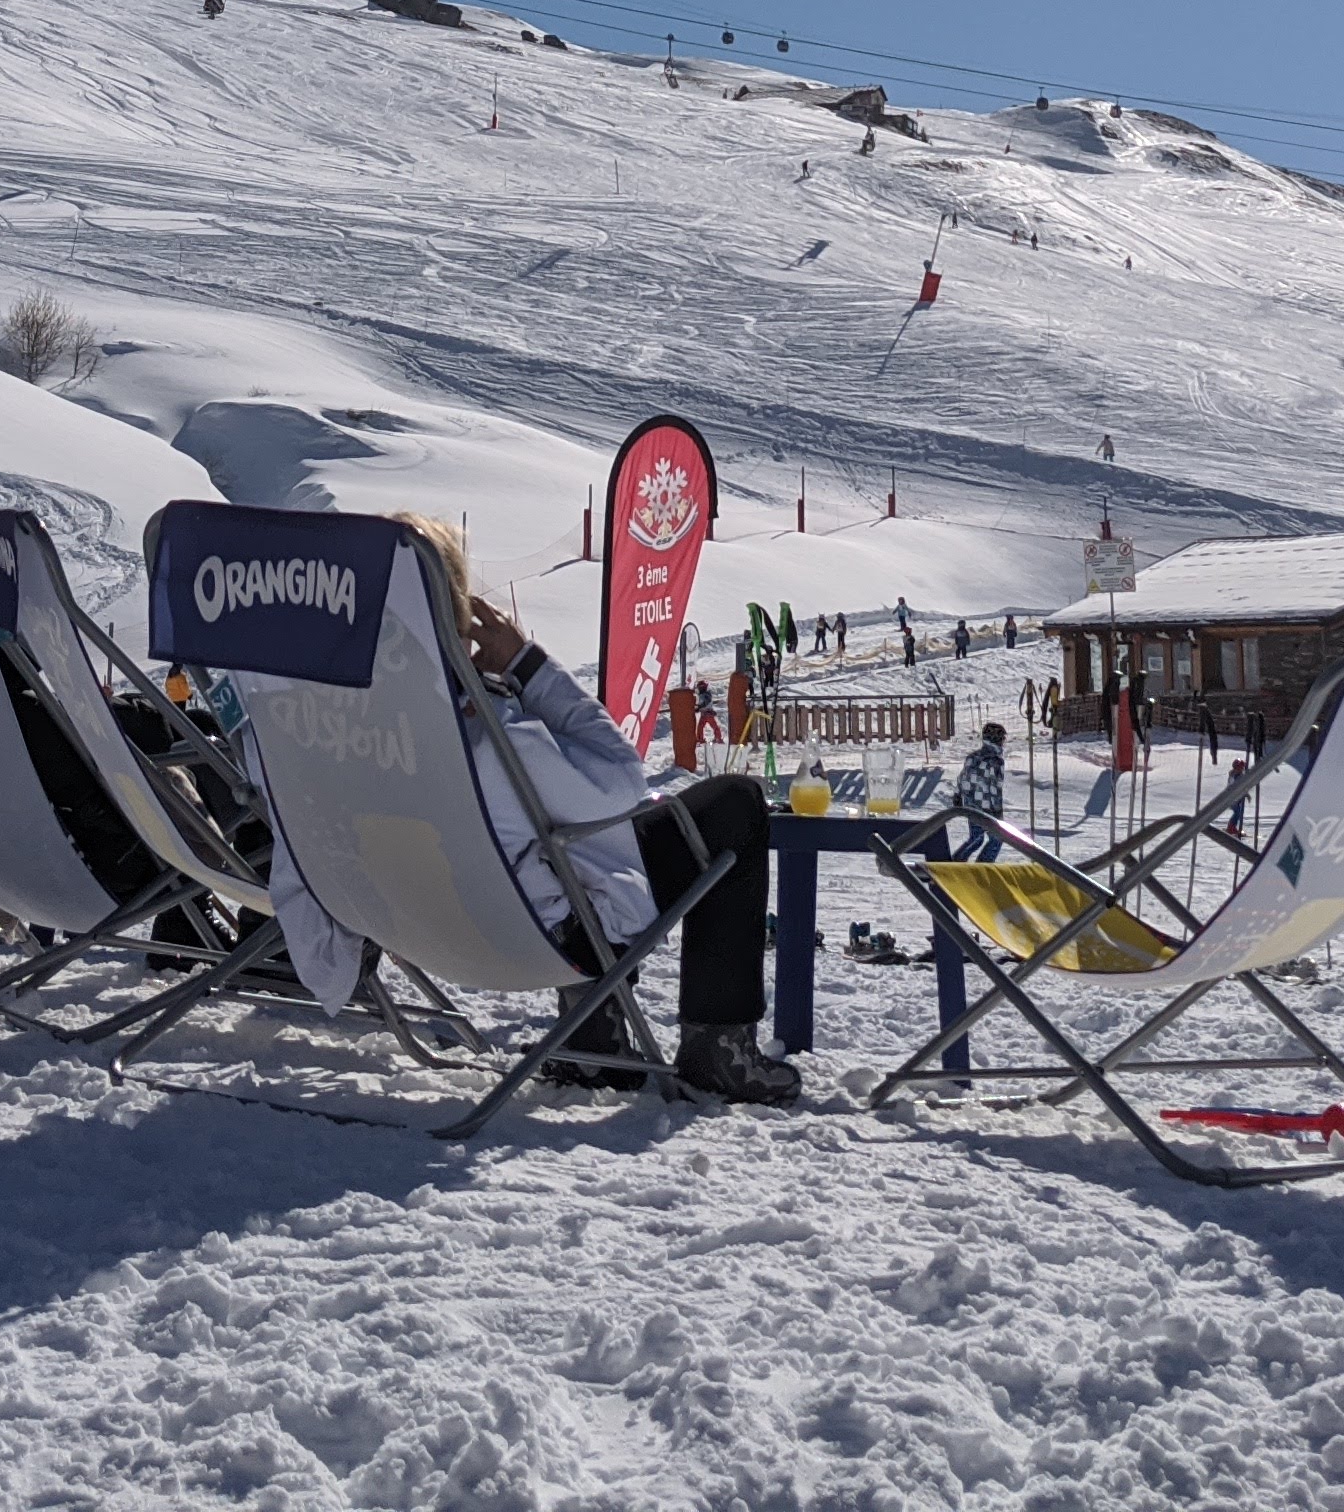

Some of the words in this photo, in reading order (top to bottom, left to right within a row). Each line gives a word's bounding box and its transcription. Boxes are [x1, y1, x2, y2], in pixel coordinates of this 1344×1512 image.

[193, 555, 356, 626] ORANGINA
[637, 566, 644, 588] 3
[646, 564, 668, 585] ème
[634, 596, 672, 627] ETOILE
